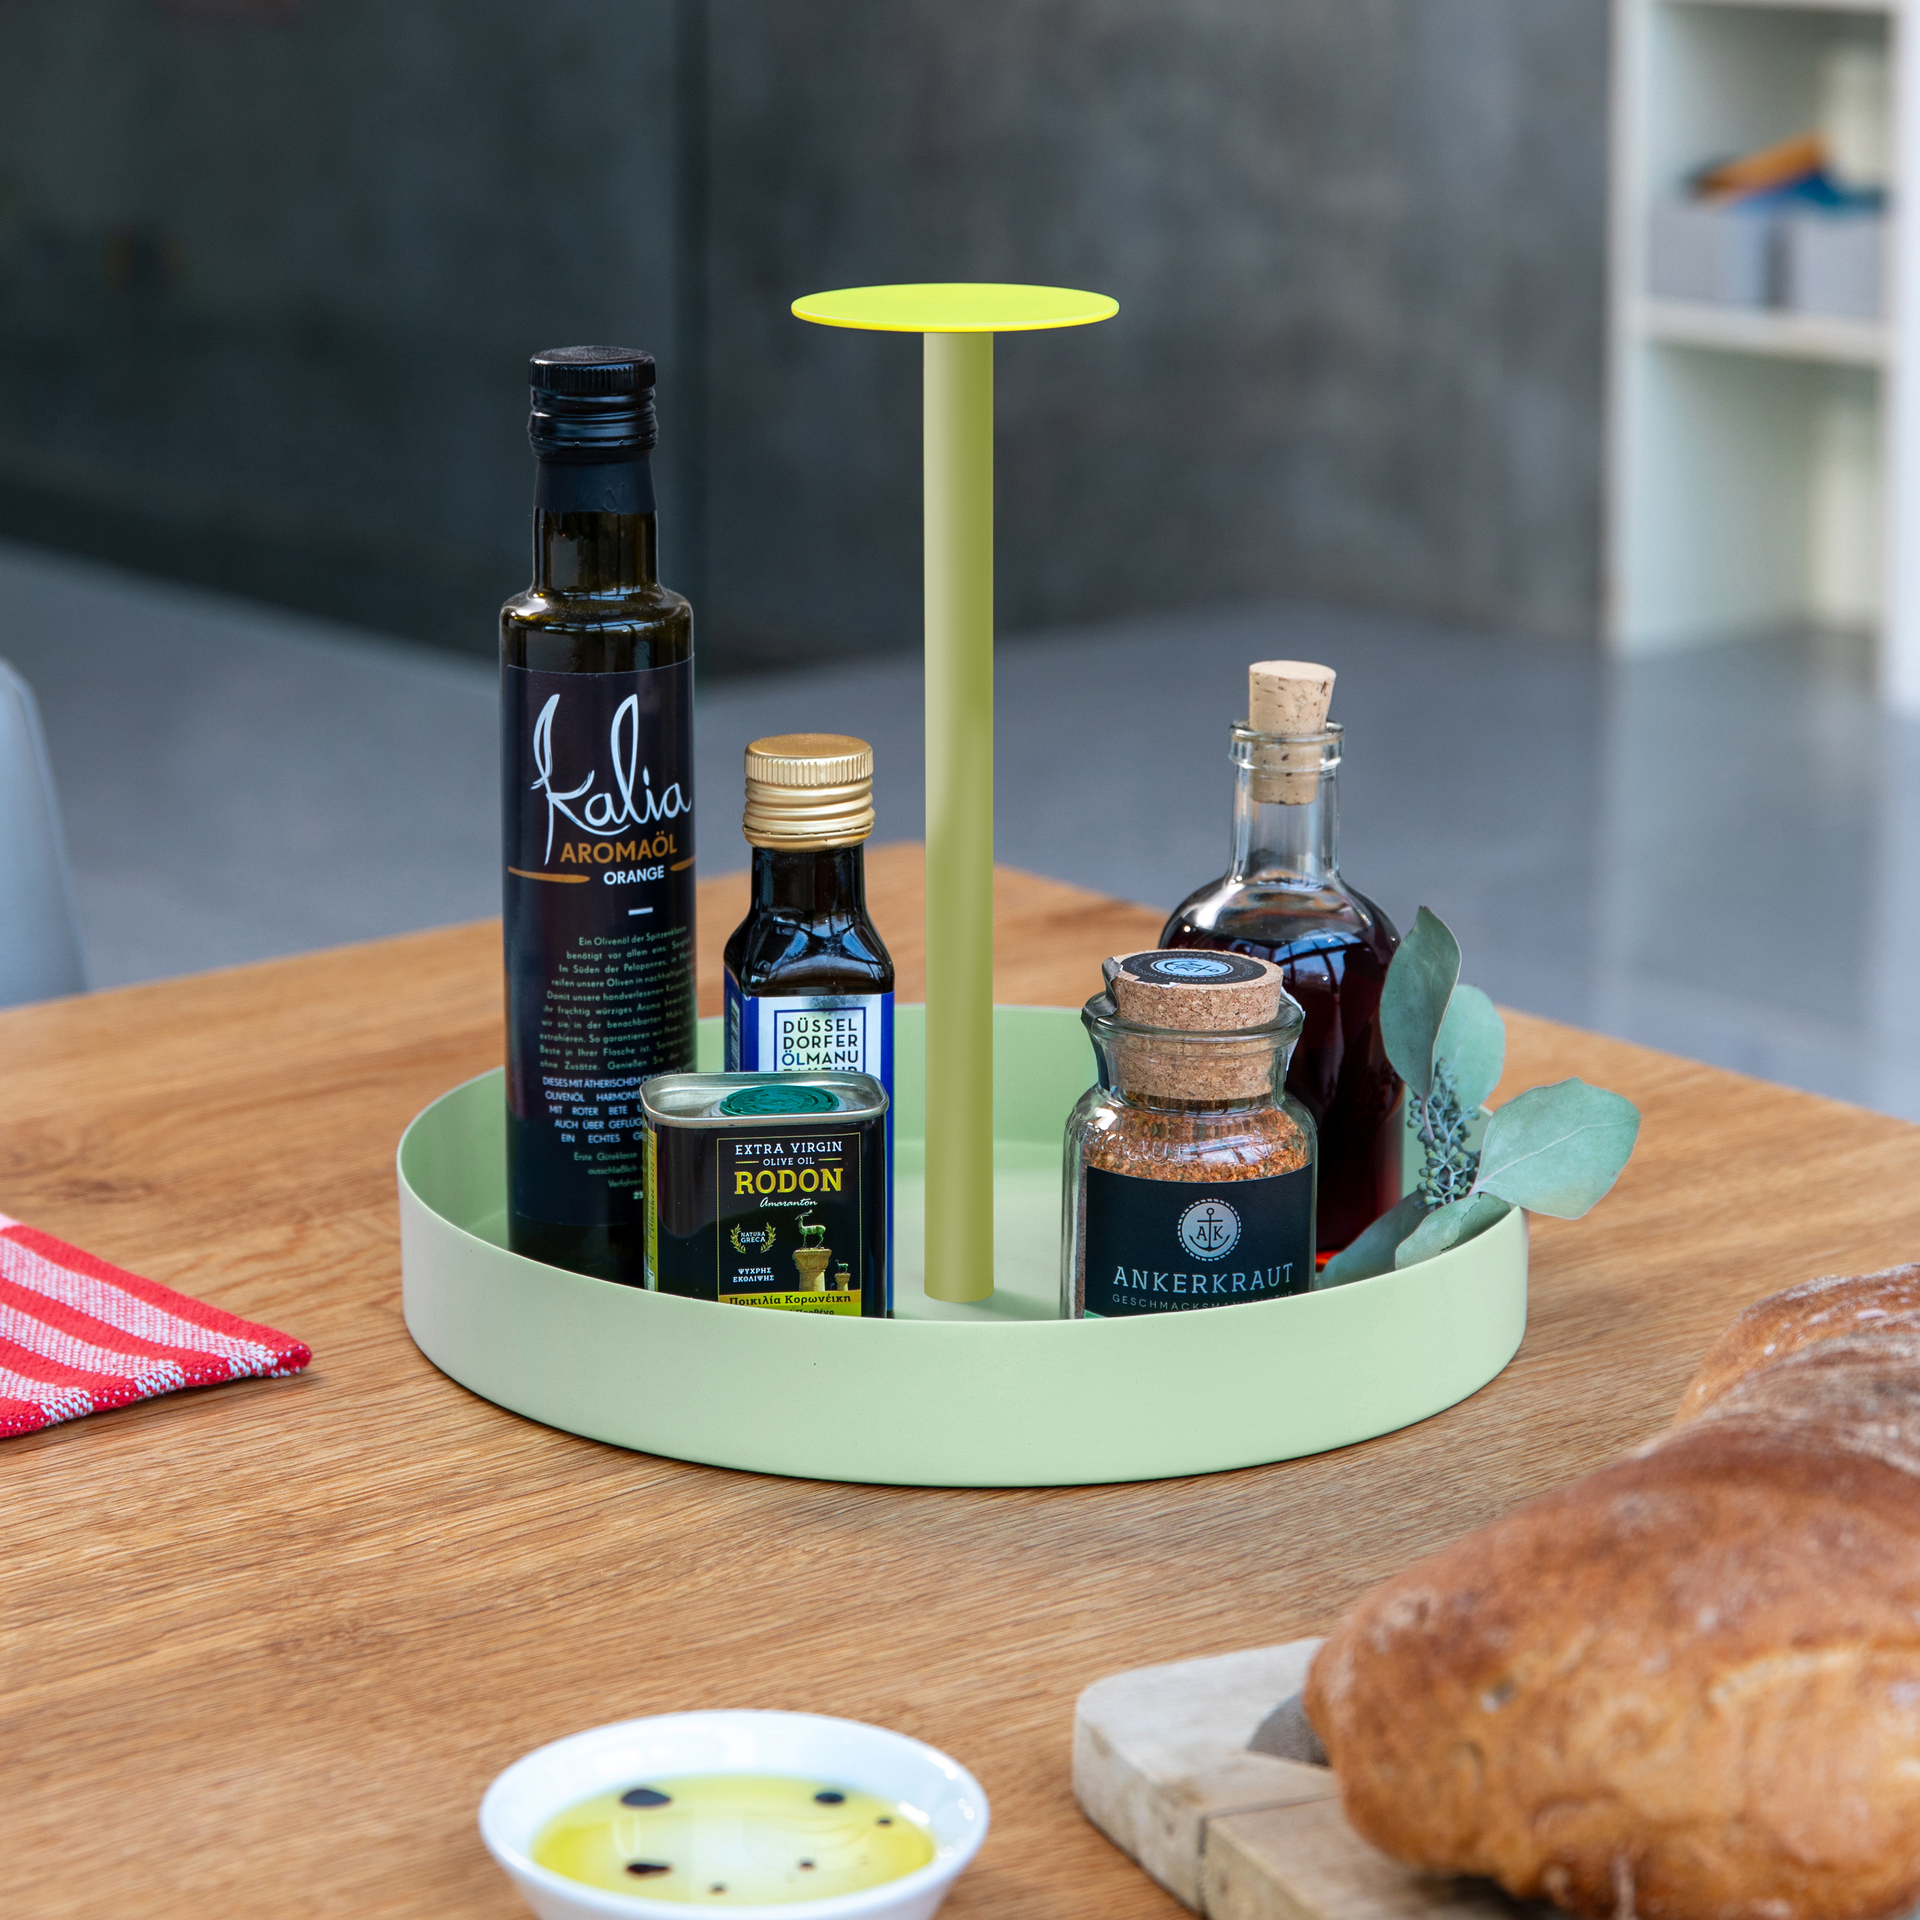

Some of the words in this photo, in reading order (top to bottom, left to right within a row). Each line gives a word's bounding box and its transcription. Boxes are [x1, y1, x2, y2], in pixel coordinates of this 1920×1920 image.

[560, 831, 677, 863] AROMAÖL
[603, 865, 664, 885] ORANGE
[578, 936, 592, 946] Ein
[594, 936, 630, 946] Olivenöl
[631, 934, 644, 944] der
[566, 950, 602, 961] benötigt
[608, 952, 622, 960] vor
[626, 948, 648, 958] allem
[559, 964, 569, 973] Im
[573, 964, 600, 974] Süden
[604, 964, 619, 973] der
[551, 978, 575, 987] reifen
[606, 977, 634, 987] Oliven
[546, 990, 570, 1001] Damit
[572, 994, 600, 1002] unsere
[603, 988, 664, 1001] handverlesenen
[558, 1005, 590, 1017] fruchtig
[595, 1006, 632, 1016] würziges
[637, 1003, 661, 1012] Aroma
[557, 1021, 569, 1029] sie
[573, 1021, 582, 1029] in
[587, 1020, 602, 1029] der
[606, 1016, 662, 1029] benachbarten
[783, 1017, 857, 1034] DÜSSEL
[588, 1034, 601, 1043] So
[603, 1032, 650, 1045] garantieren
[783, 1034, 858, 1050] DORFER
[577, 1048, 598, 1057] Ihrer
[603, 1046, 636, 1057] Flasche
[782, 1050, 859, 1066] ÖLMANU
[607, 1059, 648, 1070] Genießen
[542, 1076, 568, 1087] DIESES
[569, 1078, 583, 1088] MIT
[584, 1076, 641, 1088] ÄTHERISCHEM
[545, 1090, 585, 1102] OLIVENÖL
[596, 1090, 640, 1102] HARMONIS
[548, 1105, 563, 1114] MIT
[572, 1106, 599, 1116] ROTER
[608, 1105, 628, 1115] BETE
[554, 1118, 579, 1129] AUCH
[582, 1119, 605, 1130] ÜBER
[608, 1117, 643, 1129] GEFLÜG
[561, 1133, 576, 1143] EIN
[588, 1134, 621, 1143] ECHTES
[735, 1143, 783, 1156] EXTRA
[791, 1141, 843, 1154] VIRGIN
[762, 1158, 794, 1167] OLIVE
[797, 1157, 815, 1165] OIL
[734, 1168, 844, 1195] RODON
[760, 1197, 818, 1208] Amaranton
[1196, 1225, 1207, 1241] A
[1213, 1225, 1224, 1240] K
[740, 1236, 766, 1244] GRECA
[738, 1267, 772, 1275] ΨΥΧΡΗΣ
[1113, 1262, 1293, 1294] ANKERKRAUT
[729, 1295, 781, 1306] Ποικιλία
[785, 1293, 851, 1306] Κορωνέικη
[1112, 1288, 1293, 1311] GESCHMACKSM
